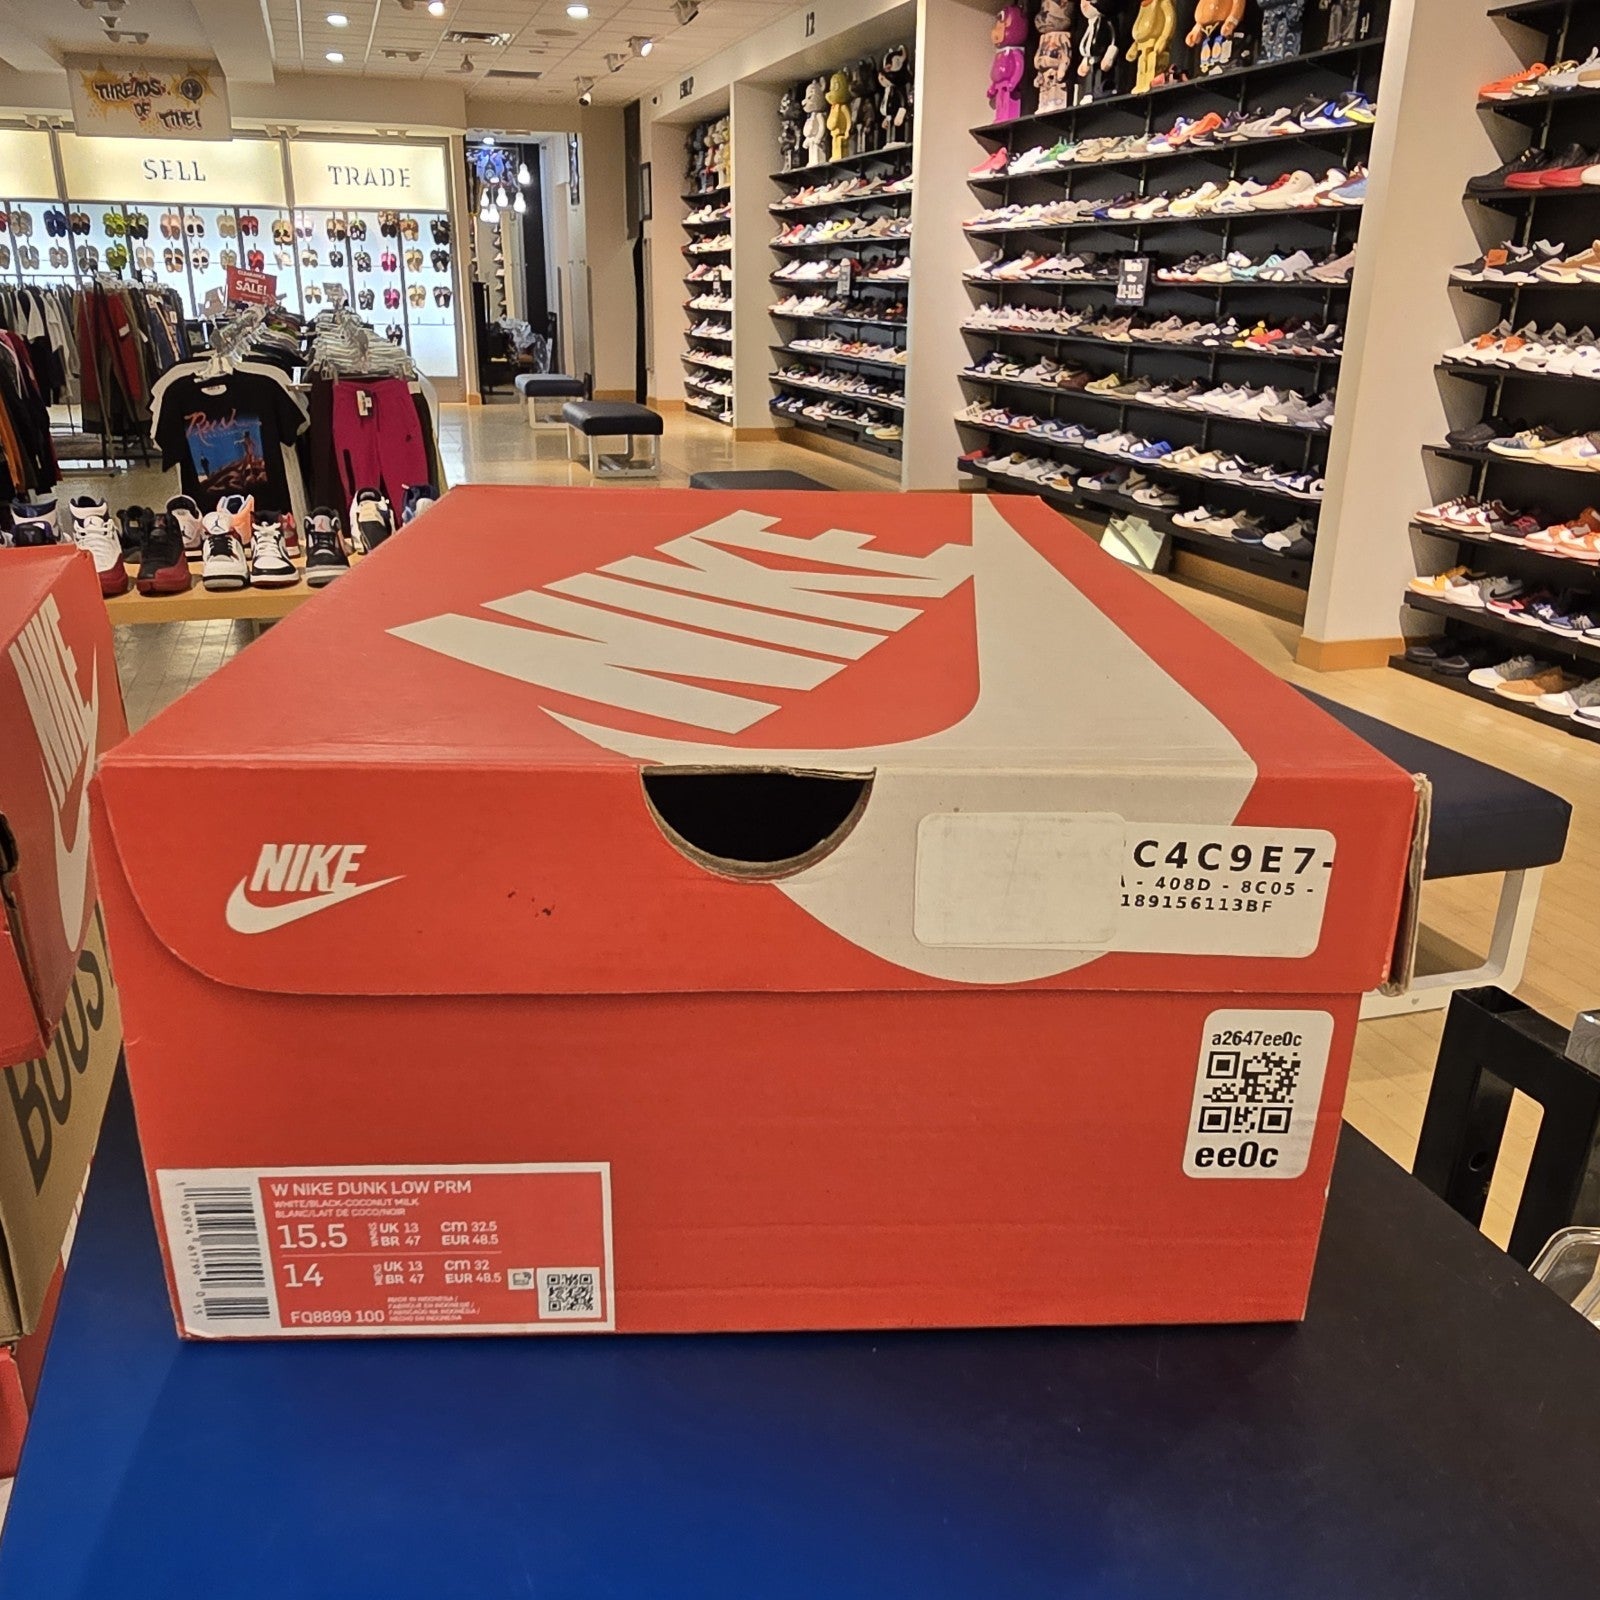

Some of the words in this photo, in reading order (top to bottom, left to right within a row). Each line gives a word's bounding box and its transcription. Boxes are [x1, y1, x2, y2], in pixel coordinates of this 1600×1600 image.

[143, 158, 206, 182] SELL
[327, 164, 411, 188] TRADE
[235, 280, 267, 295] SALE!
[385, 509, 974, 735] NIKE
[1123, 839, 1333, 875] C4C9E7-
[250, 843, 368, 892] NIKE
[1155, 876, 1211, 891] 408D
[1240, 880, 1296, 896] 8C05
[1120, 893, 1273, 913] 189156113BF
[1212, 1030, 1303, 1046] a2647ee0c
[1194, 1141, 1279, 1168] ee0c
[271, 1183, 289, 1197] W
[293, 1182, 334, 1196] NIKE
[338, 1181, 388, 1195] DUNK
[391, 1181, 430, 1195] LOW
[434, 1180, 472, 1194] PRM
[379, 1222, 399, 1234] UK
[404, 1222, 419, 1234] 13
[472, 1221, 498, 1232] 32.5
[276, 1223, 348, 1249] 15.5
[381, 1235, 400, 1247] BR
[404, 1235, 421, 1246] 47
[441, 1235, 470, 1246] EUR
[472, 1234, 499, 1245] 48.5
[383, 1261, 404, 1272] UK
[408, 1261, 423, 1272] 13
[474, 1260, 490, 1271] 32
[283, 1263, 324, 1288] 14
[385, 1274, 404, 1285] BR
[409, 1273, 424, 1284] 47
[445, 1273, 473, 1284] EUR
[475, 1272, 502, 1283] 48.5
[291, 1309, 352, 1324] FQ8899
[355, 1309, 385, 1323] 100
